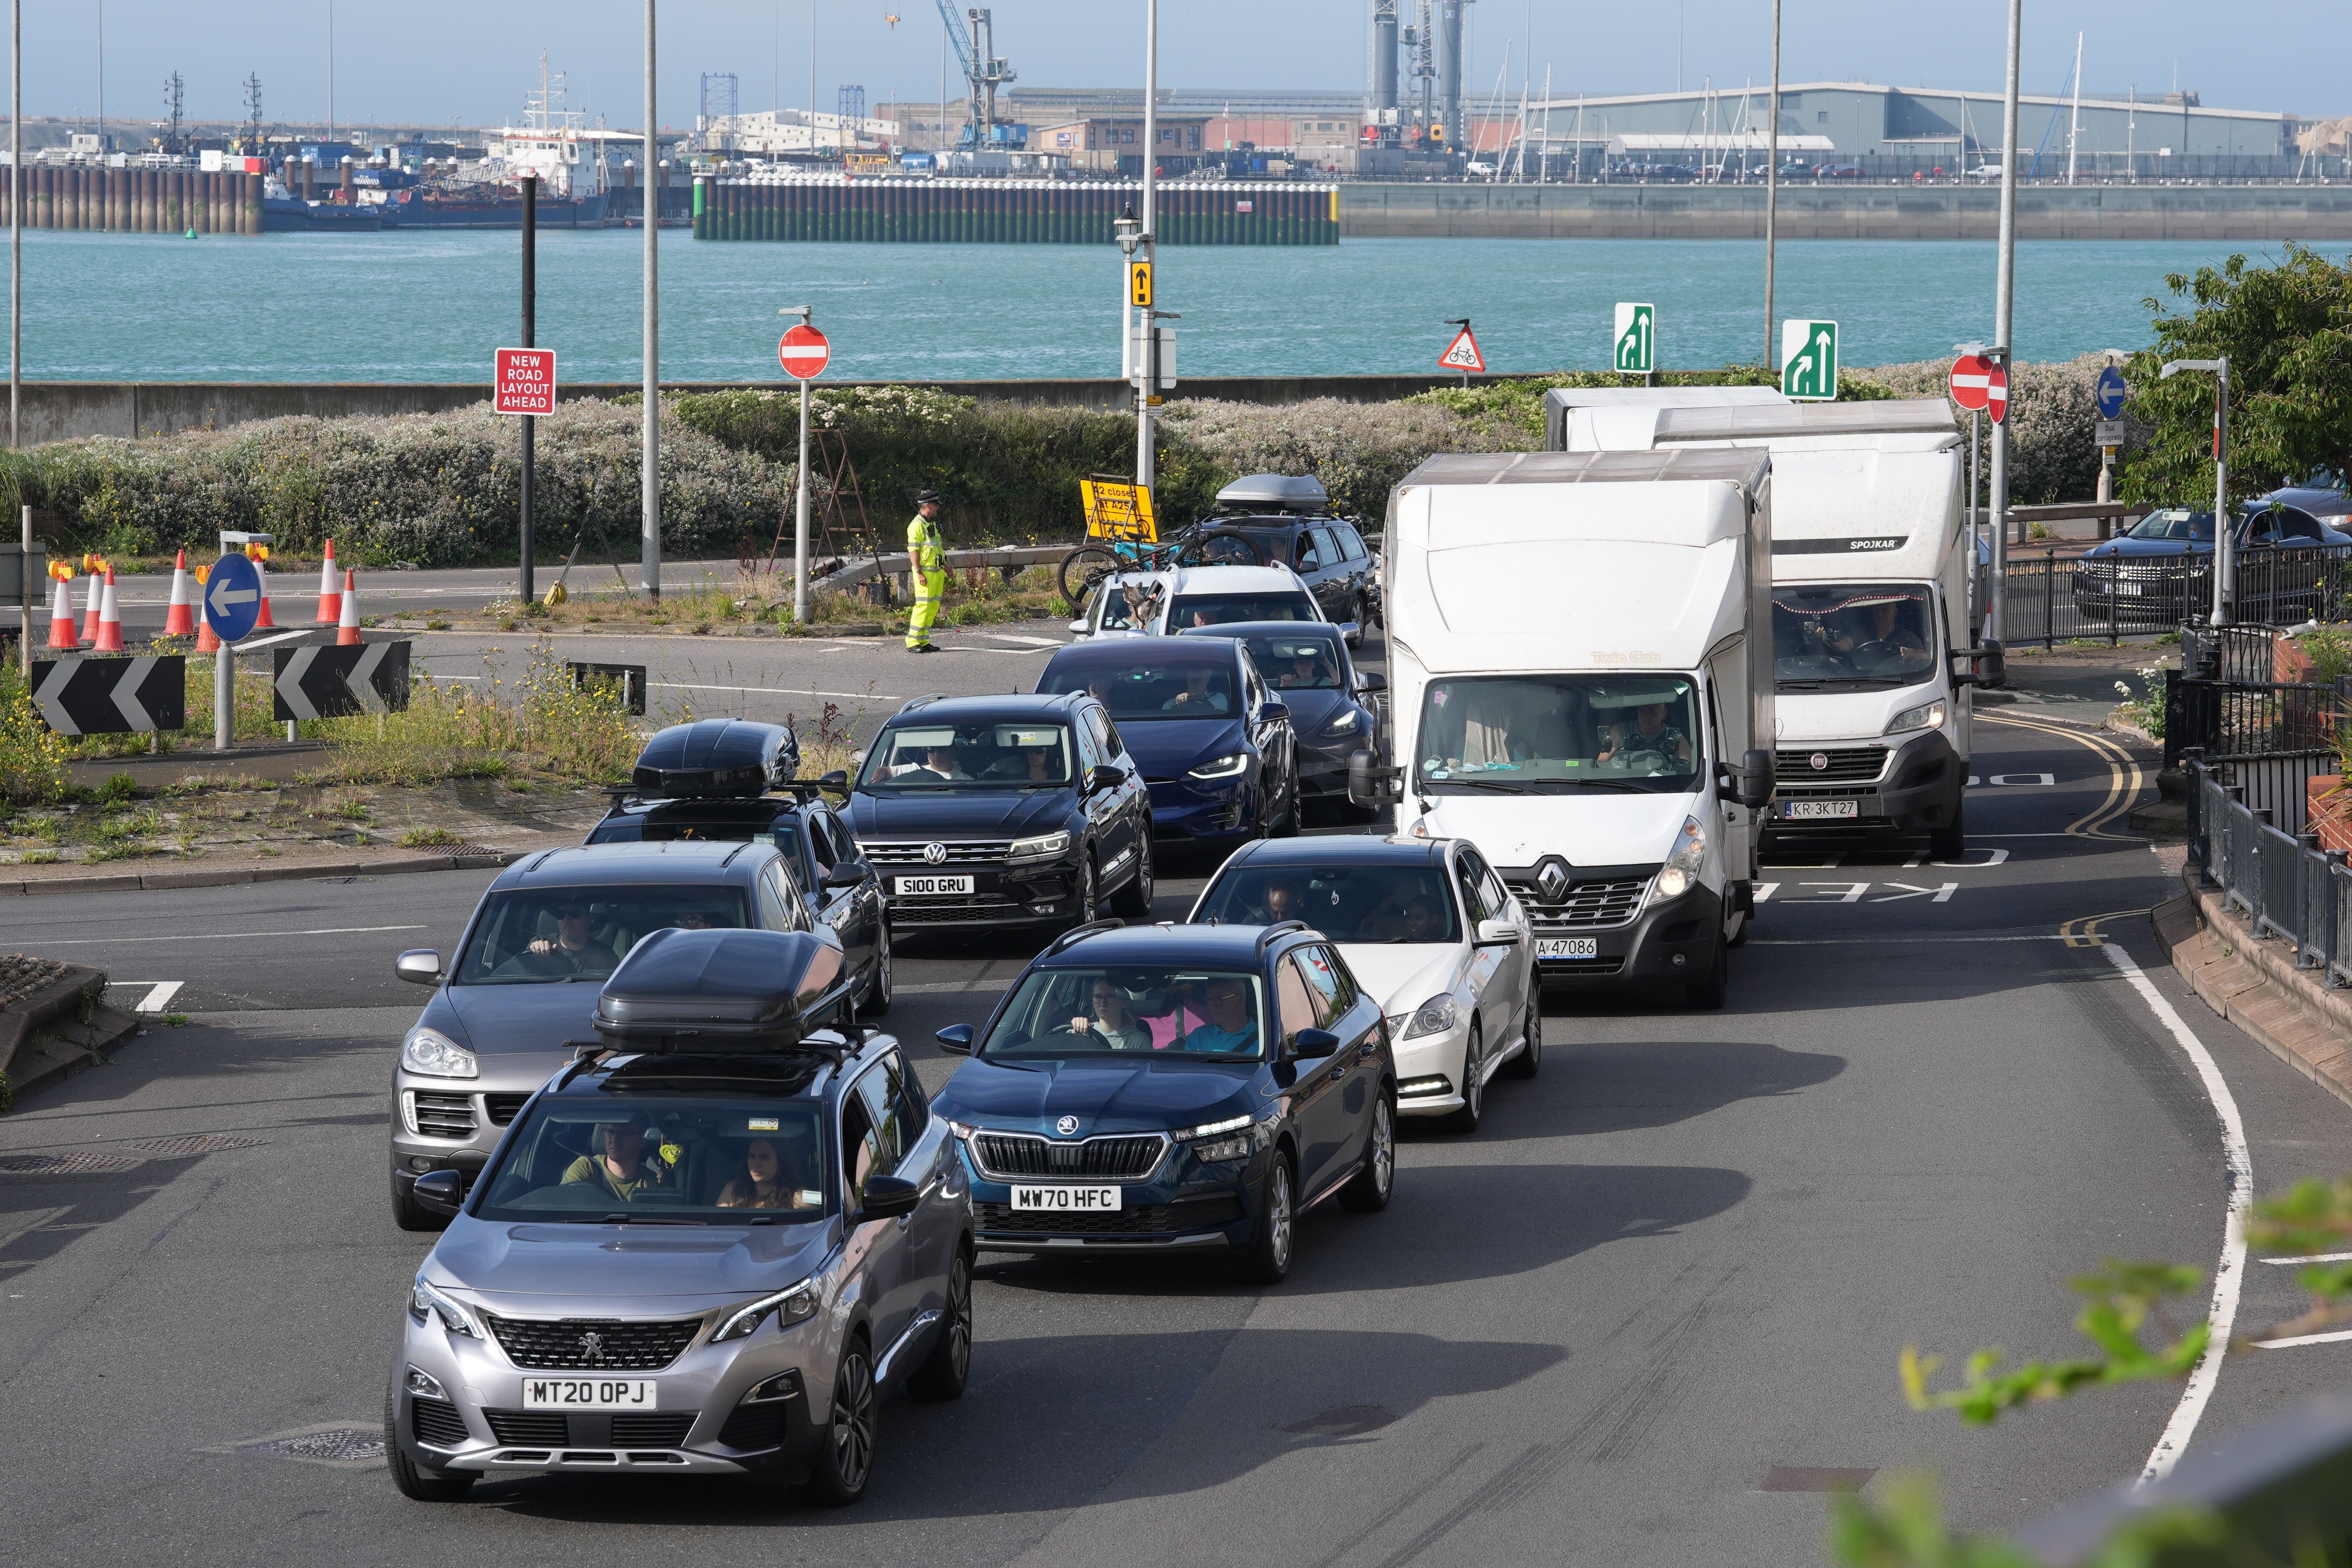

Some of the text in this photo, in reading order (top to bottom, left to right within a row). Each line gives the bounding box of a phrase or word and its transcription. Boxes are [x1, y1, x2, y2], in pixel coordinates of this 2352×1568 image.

[511, 355, 540, 367] NEW
[508, 369, 543, 381] ROAD
[502, 382, 549, 394] LAYOUT
[503, 396, 546, 408] AHEAD
[1093, 486, 1104, 494] A2
[1850, 540, 1895, 549] SPOJKAR
[1590, 651, 1662, 663] Twin Cab
[1815, 757, 1825, 766] FIAT
[1794, 802, 1853, 815] KR 3KT27
[938, 879, 965, 891] GRU
[1551, 940, 1594, 954] 47086
[1020, 1189, 1112, 1207] MW70 HFC
[534, 1382, 644, 1403] MT20 OPJ
